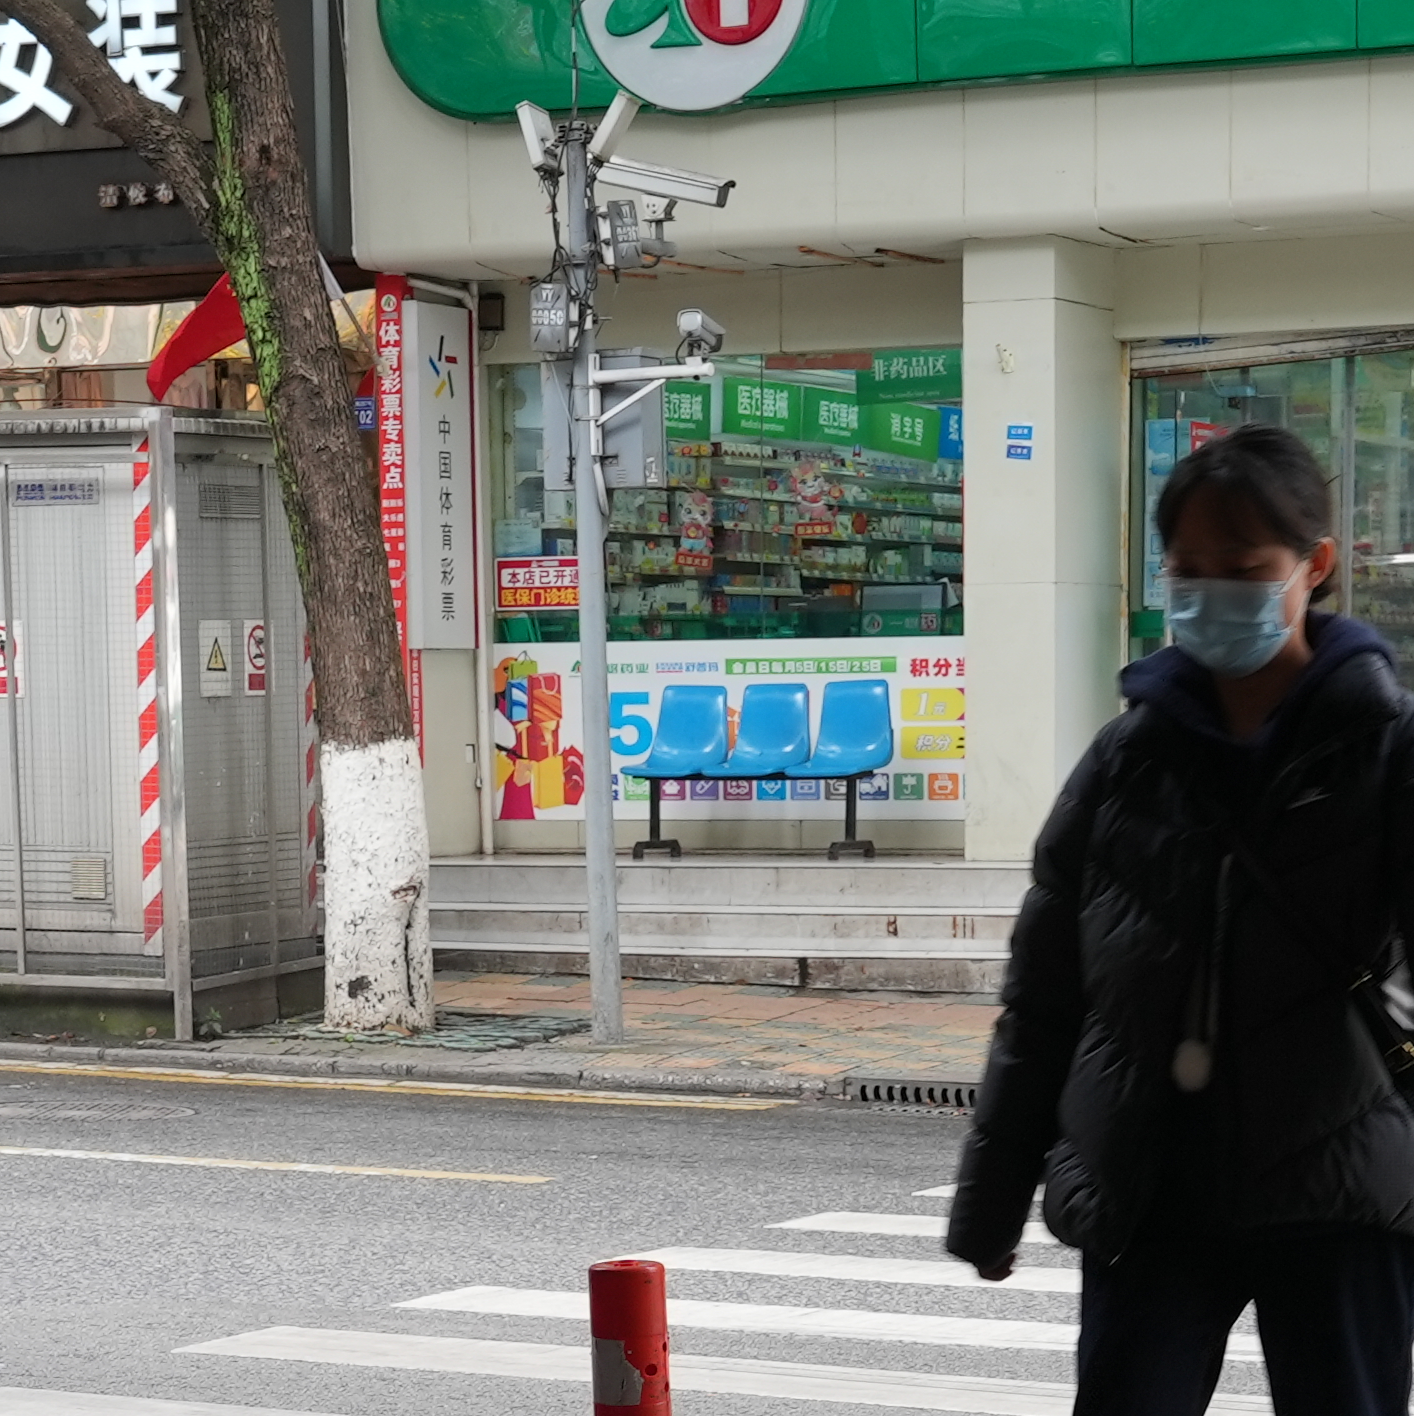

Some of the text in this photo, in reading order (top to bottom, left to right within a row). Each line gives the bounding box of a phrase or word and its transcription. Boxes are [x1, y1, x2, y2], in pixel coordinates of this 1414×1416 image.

[872, 355, 948, 382] 非药品区
[378, 321, 404, 490] 体育彩票专卖点
[737, 385, 789, 420] 医疗器械
[438, 414, 456, 621] 中国体育彩票
[507, 568, 579, 587] 本店已开通
[501, 587, 579, 607] 医保门诊统
[608, 691, 654, 757] 5
[915, 734, 952, 752] 积分
